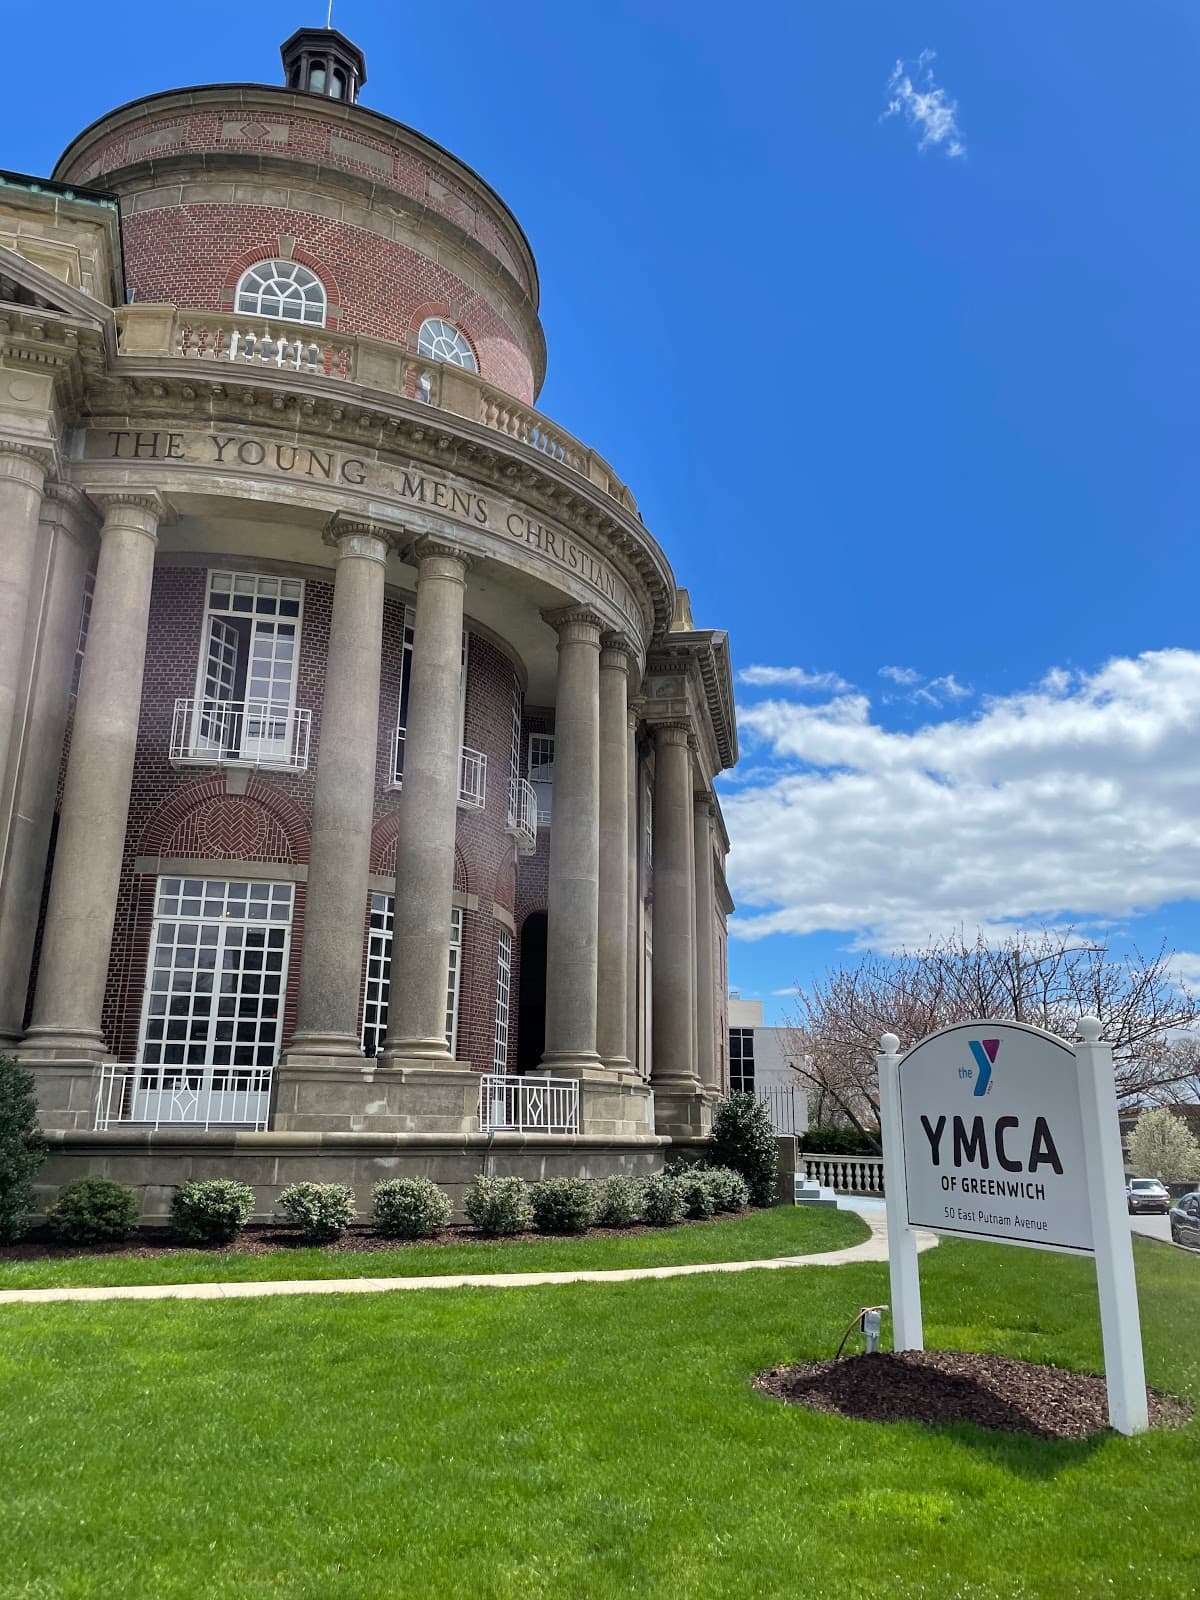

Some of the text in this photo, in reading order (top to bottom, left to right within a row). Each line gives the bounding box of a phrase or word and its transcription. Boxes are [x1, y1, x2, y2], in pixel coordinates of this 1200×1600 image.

[108, 431, 616, 601] THE YOUNG MEN'S CHRISTIAN
[958, 1066, 973, 1079] the
[920, 1115, 1064, 1175] YMCA
[941, 1175, 1045, 1201] OF GREENWICH
[944, 1206, 1048, 1230] 50 East Putnam Avenue
